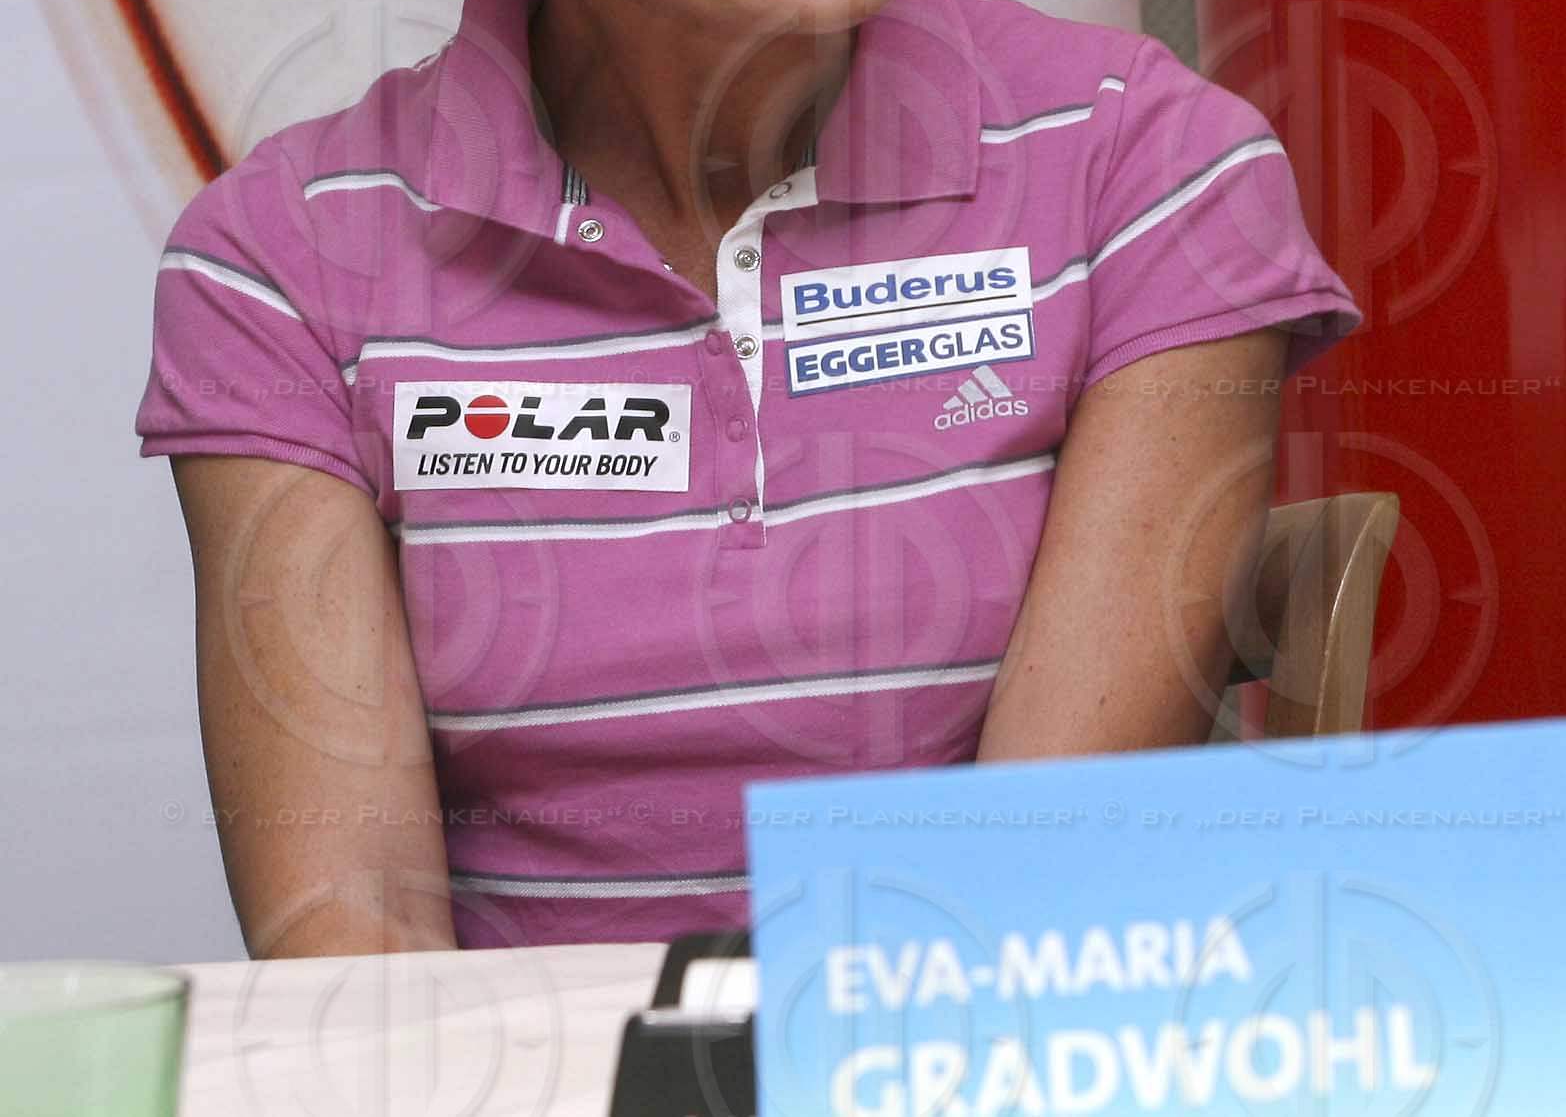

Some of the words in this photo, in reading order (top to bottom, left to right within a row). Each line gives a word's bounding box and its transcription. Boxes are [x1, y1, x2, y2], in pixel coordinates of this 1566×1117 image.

[793, 266, 1017, 316] Buderus
[795, 323, 1025, 384] EGGERGLAS
[406, 394, 671, 442] POLAR
[933, 398, 1029, 431] adidas
[417, 452, 496, 477] LISTEN
[499, 452, 528, 475] TO
[533, 453, 593, 477] YOUR
[594, 454, 659, 478] BODY
[826, 914, 1252, 1014] EVA-MARIA
[830, 1004, 1438, 1117] GRADWOHL
